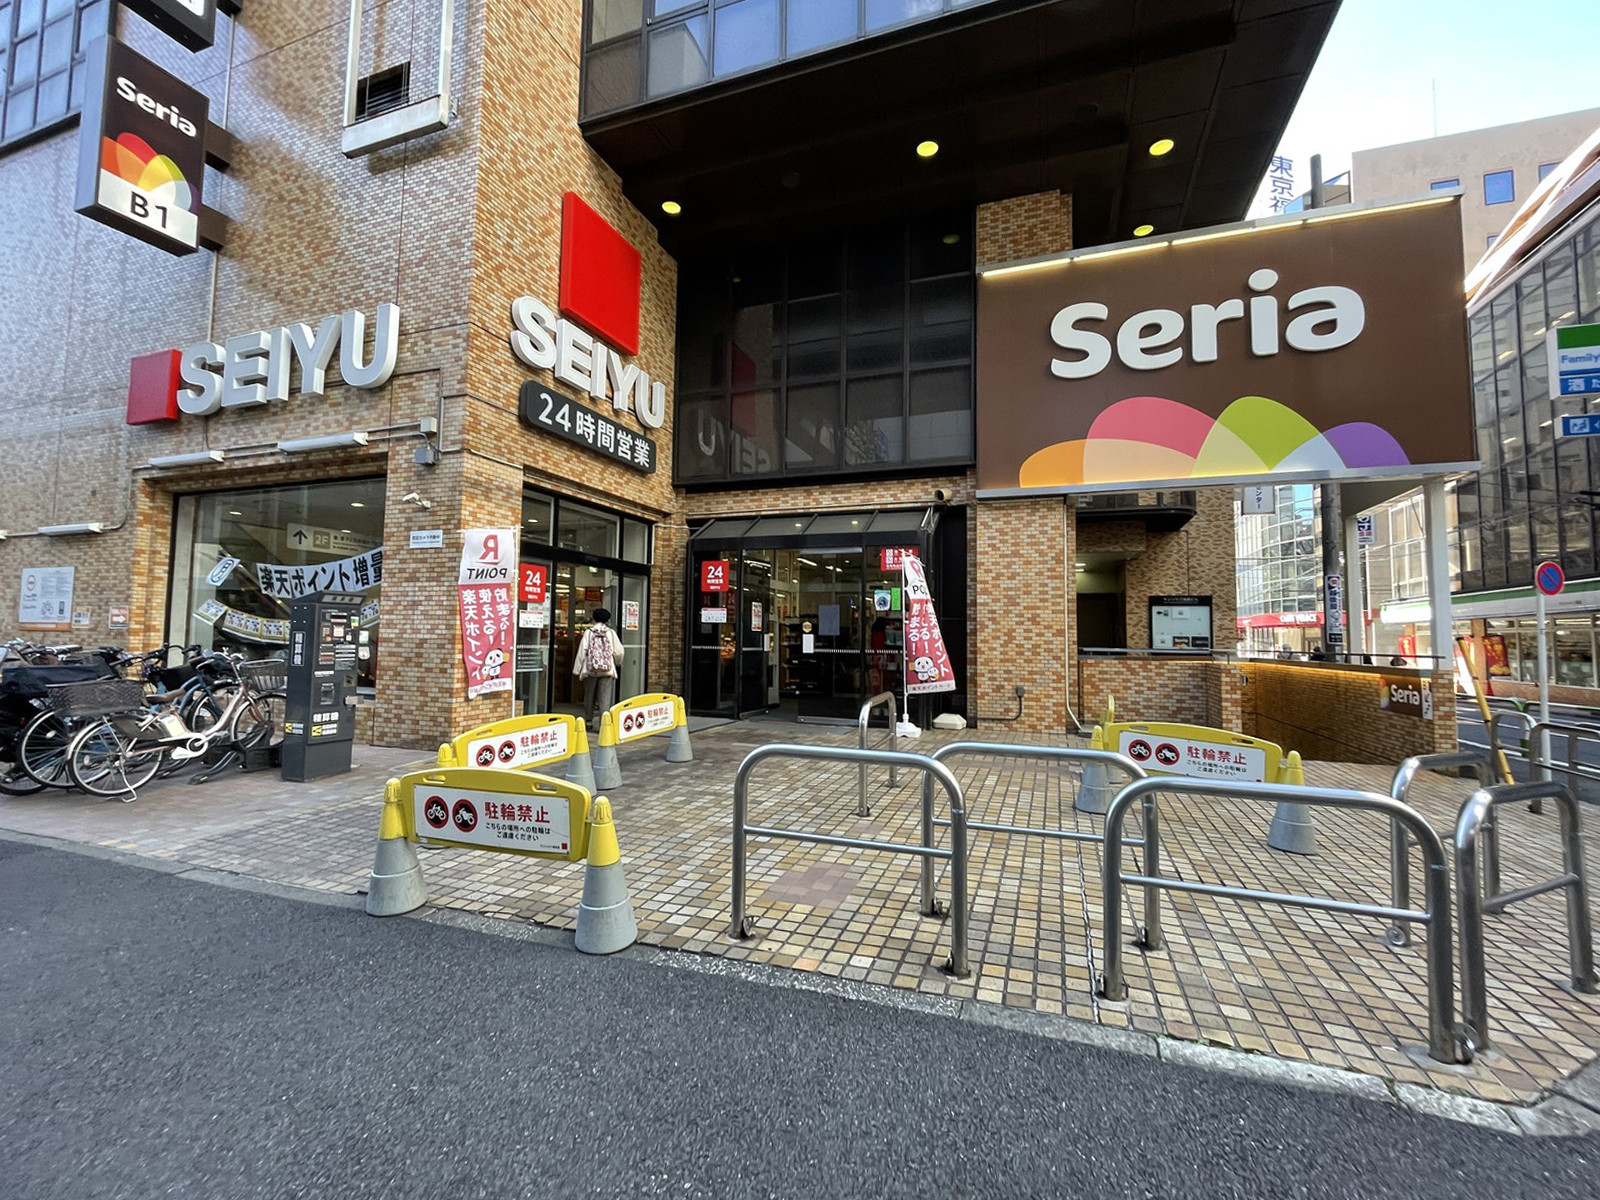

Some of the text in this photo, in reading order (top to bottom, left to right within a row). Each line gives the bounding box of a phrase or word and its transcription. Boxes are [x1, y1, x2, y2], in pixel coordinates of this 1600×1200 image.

[116, 76, 197, 138] Seria
[130, 191, 168, 229] B1
[1050, 268, 1366, 379] Seria
[177, 303, 400, 416] SEIYU
[511, 296, 665, 428] SEIYU
[538, 392, 650, 468] 24時間営業
[1255, 487, 1263, 510] ンター
[259, 550, 383, 596] 楽天ポイント増量
[525, 570, 542, 586] 24
[707, 565, 724, 579] 24
[1390, 684, 1420, 705] Seria
[520, 730, 558, 747] 駐輪禁止
[1187, 746, 1247, 765] 駐輪禁止
[484, 801, 550, 823] 駐輪禁止
[485, 822, 551, 834] こちらの場所への駐輪は
[497, 831, 539, 841] ご遠慮ください
